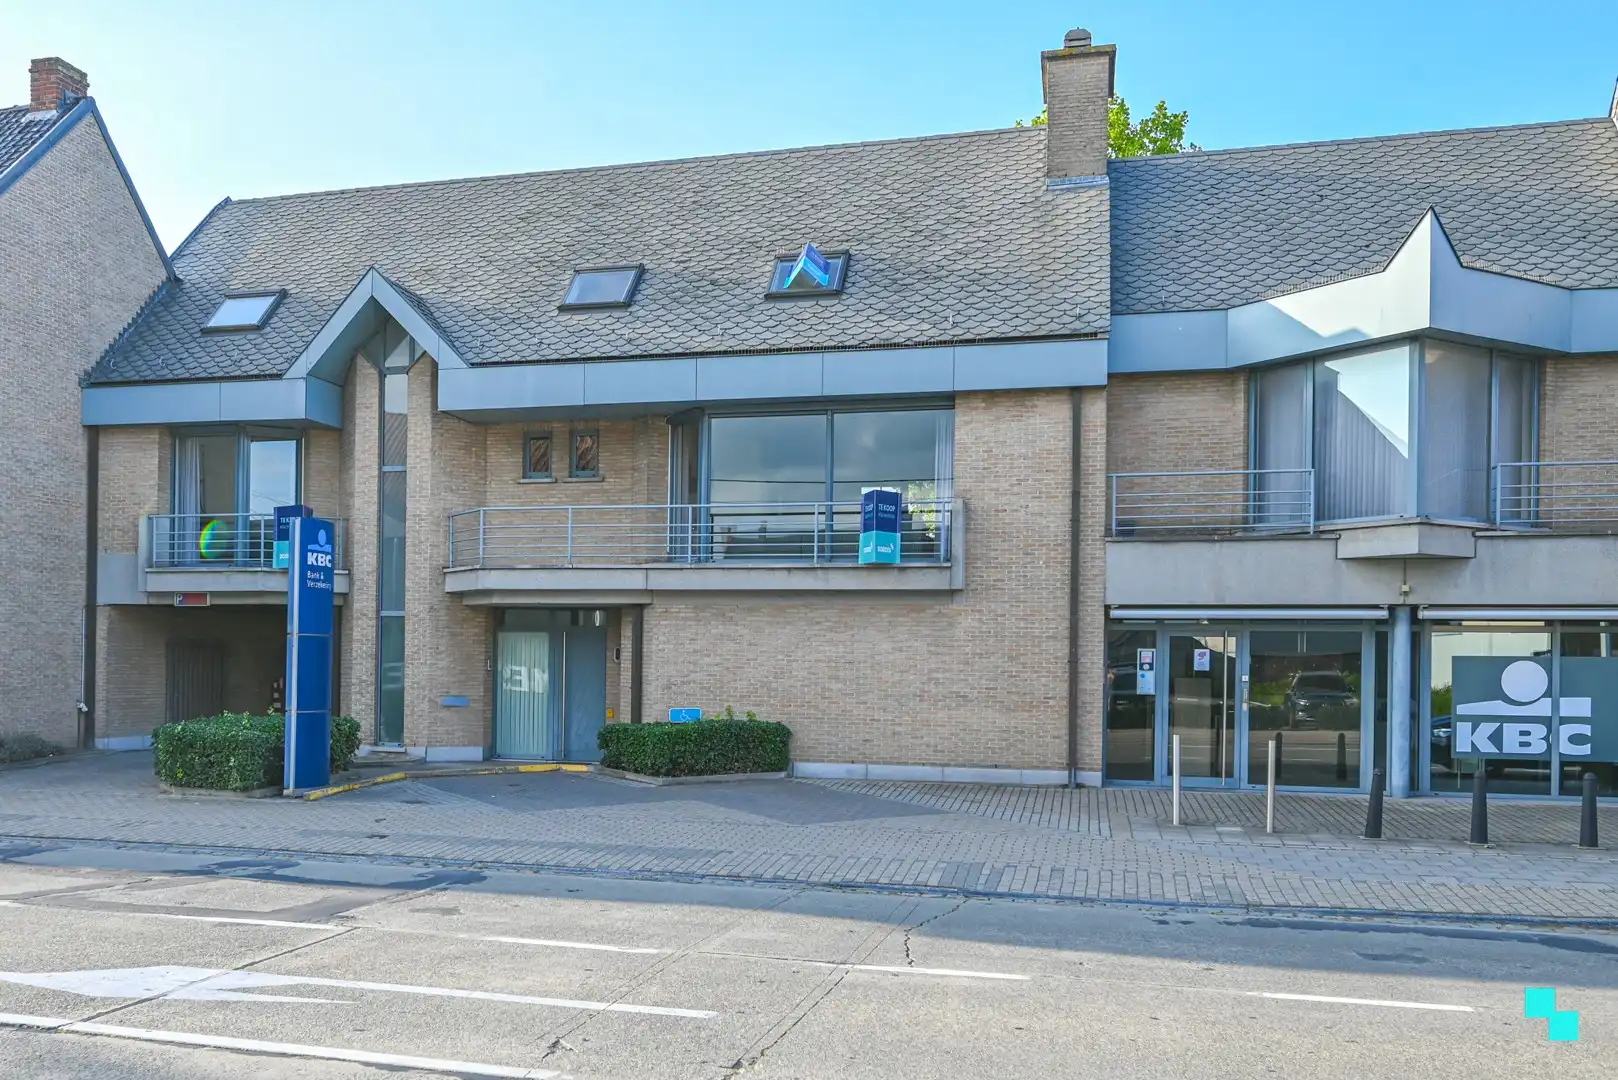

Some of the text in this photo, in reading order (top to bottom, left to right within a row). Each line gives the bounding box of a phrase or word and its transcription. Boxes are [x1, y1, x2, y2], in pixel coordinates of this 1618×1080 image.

[307, 552, 332, 568] KBC
[307, 570, 320, 580] Bank
[176, 593, 184, 605] P
[1455, 721, 1592, 755] KBC
